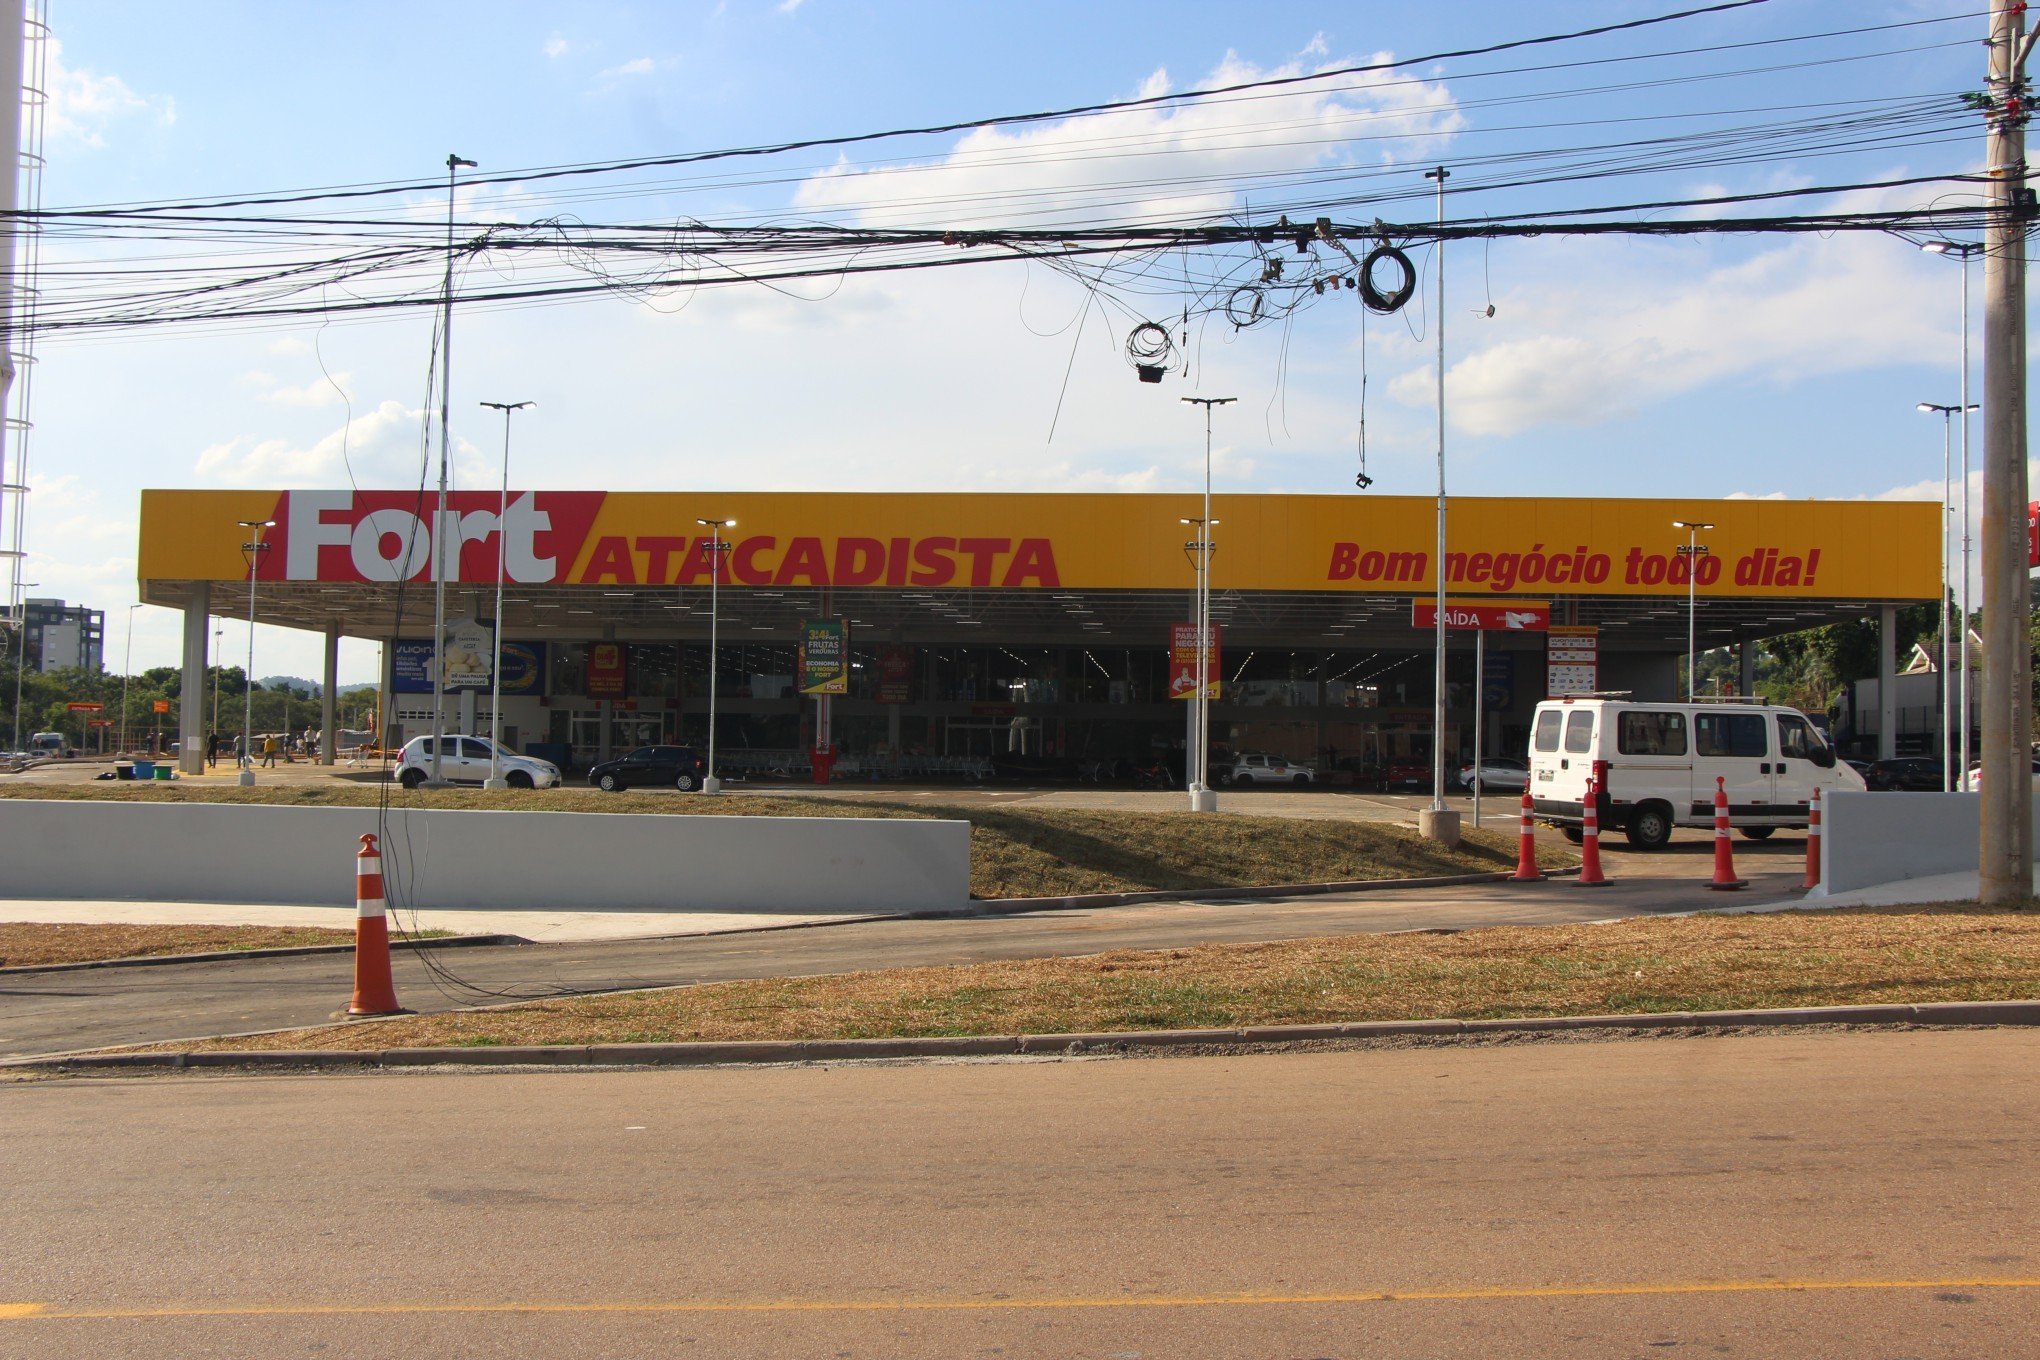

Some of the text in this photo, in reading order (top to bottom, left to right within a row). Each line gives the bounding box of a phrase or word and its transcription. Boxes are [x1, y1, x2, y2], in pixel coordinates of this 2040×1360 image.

[286, 490, 557, 583] Fort
[579, 535, 1061, 588] ATACADISTA
[1327, 542, 1821, 592] Bom negócio todo dia!
